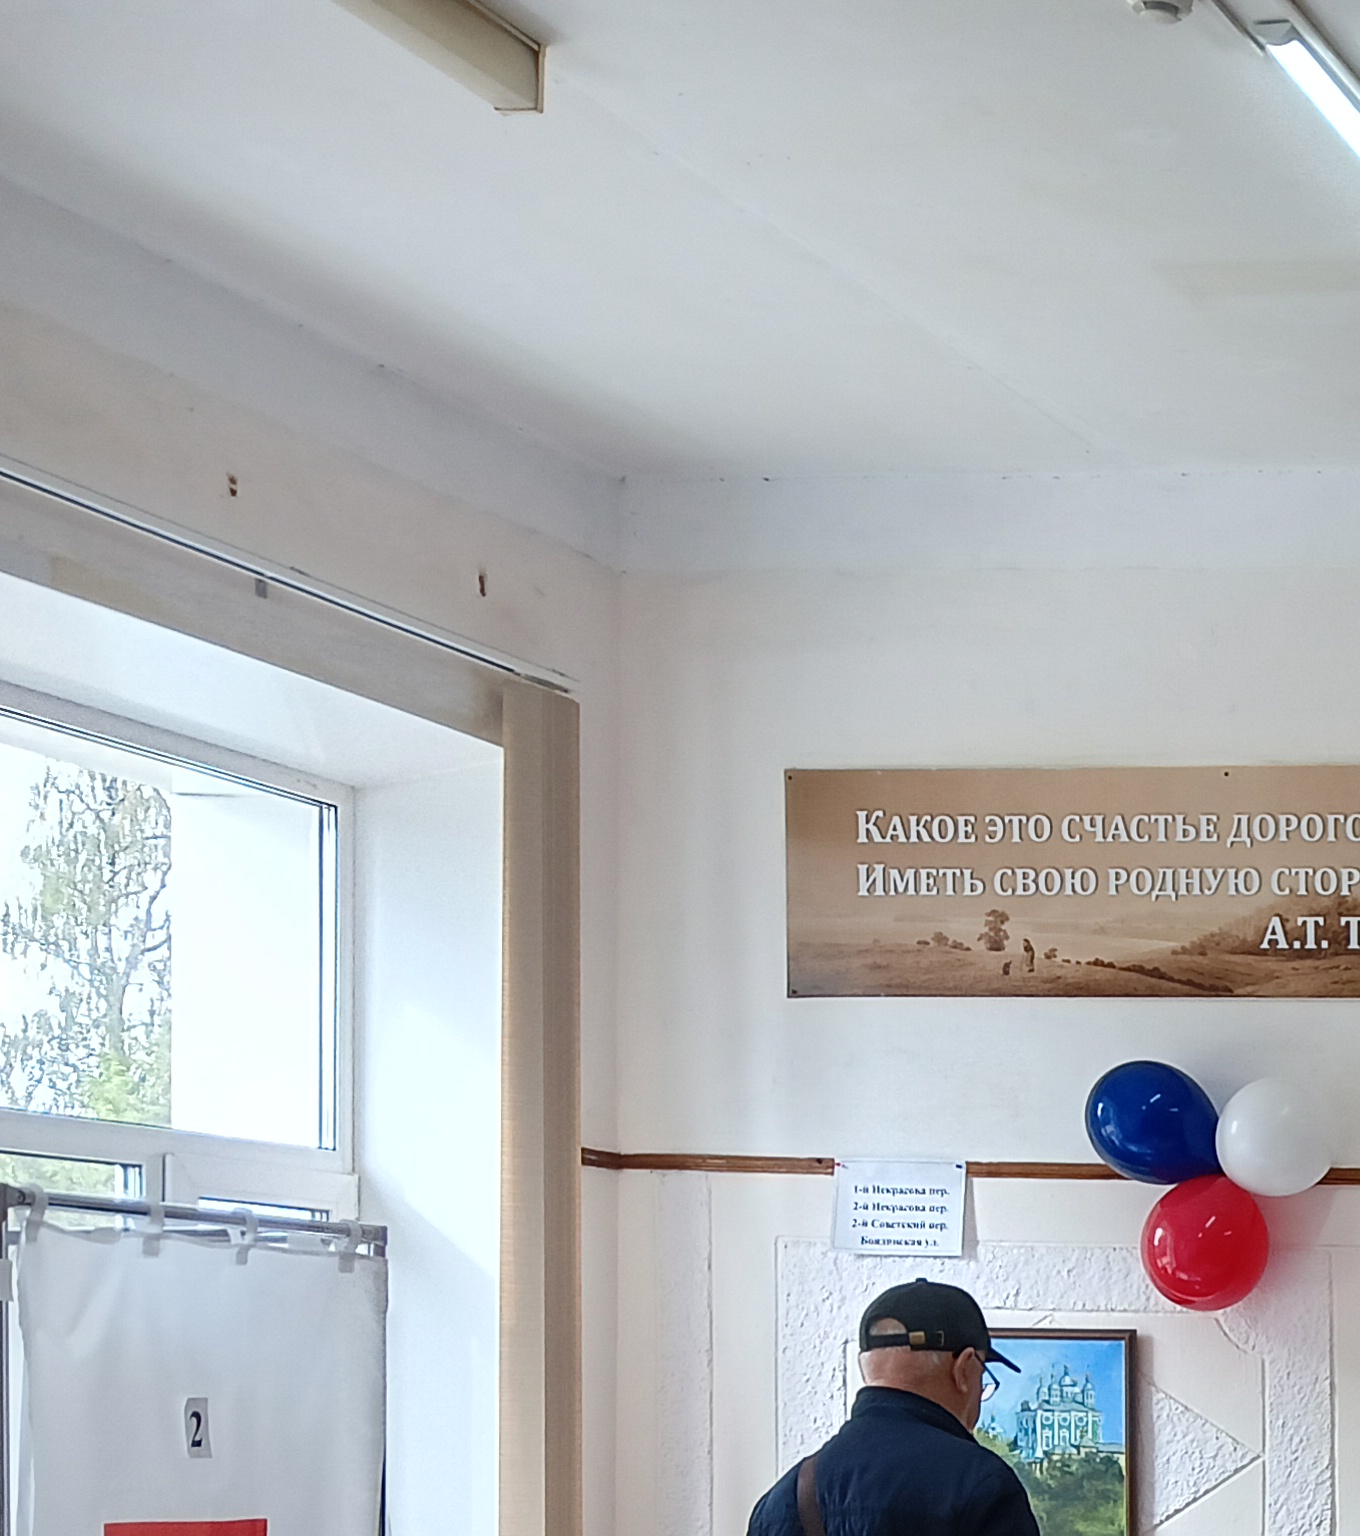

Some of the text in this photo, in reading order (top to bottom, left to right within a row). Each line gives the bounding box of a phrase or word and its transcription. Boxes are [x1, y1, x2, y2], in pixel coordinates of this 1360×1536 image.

[856, 810, 977, 843] КАКОЕ
[985, 814, 1052, 843] ЭТО
[1062, 814, 1219, 843] СЧАСТЬЕ
[856, 864, 986, 897] ИМЕТЬ
[994, 867, 1097, 896] СВОЮ
[1108, 867, 1260, 902] РОДНУЮ
[1259, 916, 1329, 950] А.Т.
[871, 1219, 926, 1230] Советский
[190, 1410, 203, 1448] 2
